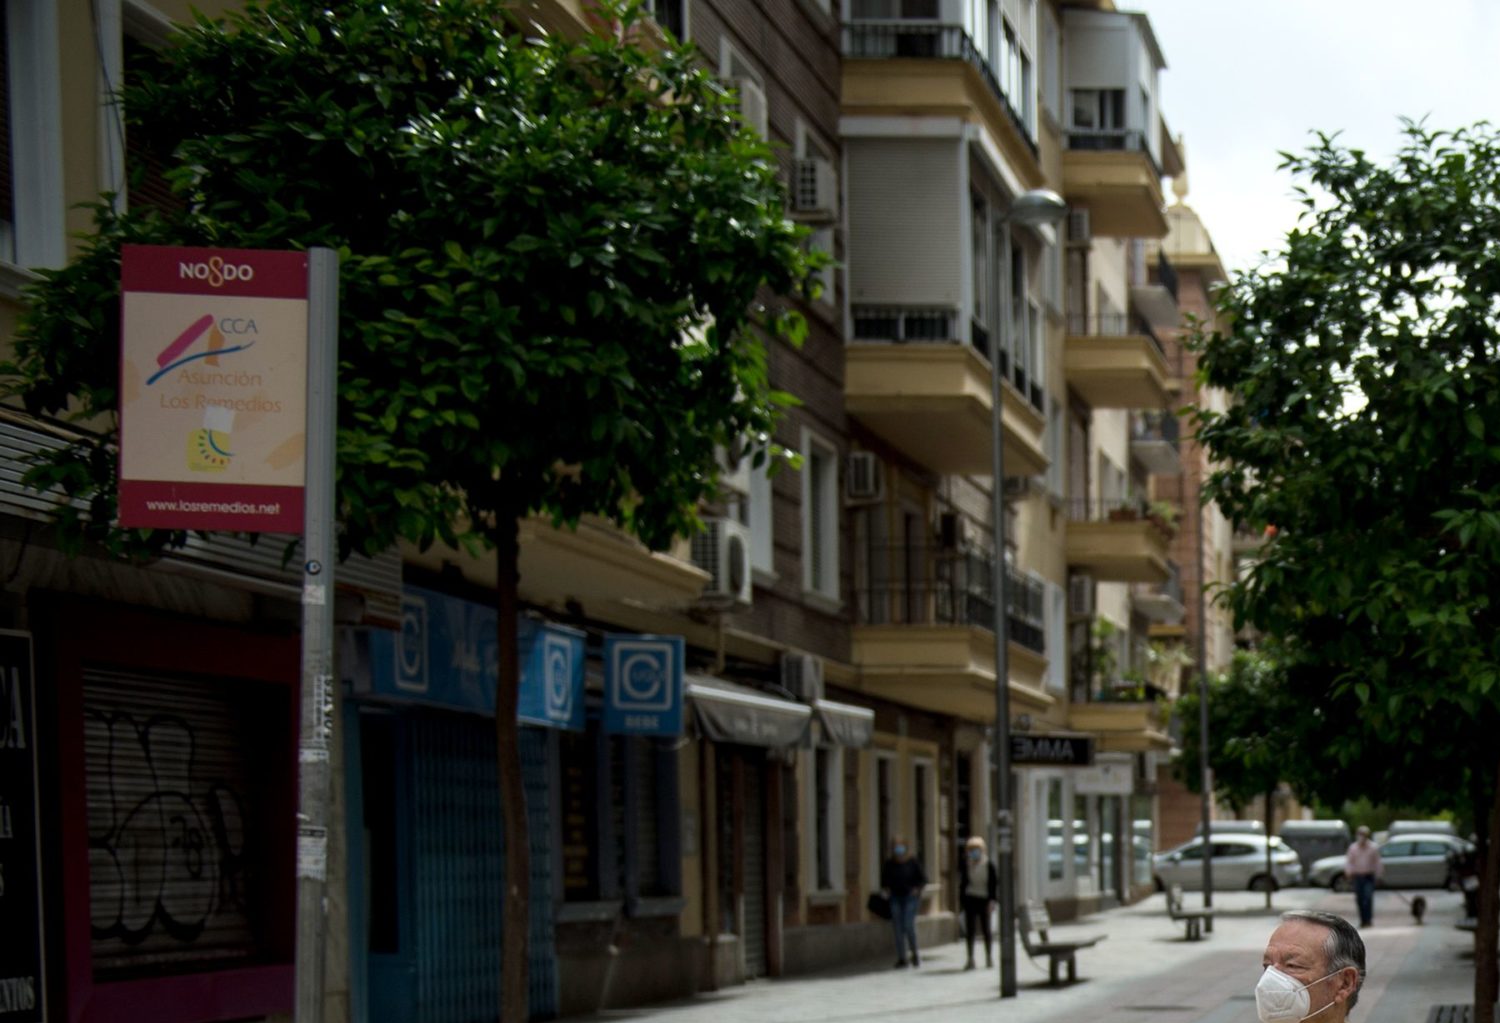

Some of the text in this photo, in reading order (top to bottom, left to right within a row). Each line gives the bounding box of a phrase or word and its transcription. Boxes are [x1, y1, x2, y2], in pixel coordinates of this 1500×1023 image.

[220, 318, 258, 335] CCA
[178, 369, 262, 386] Asunción
[160, 394, 189, 409] Los
[146, 499, 280, 514] www.losremedios.net
